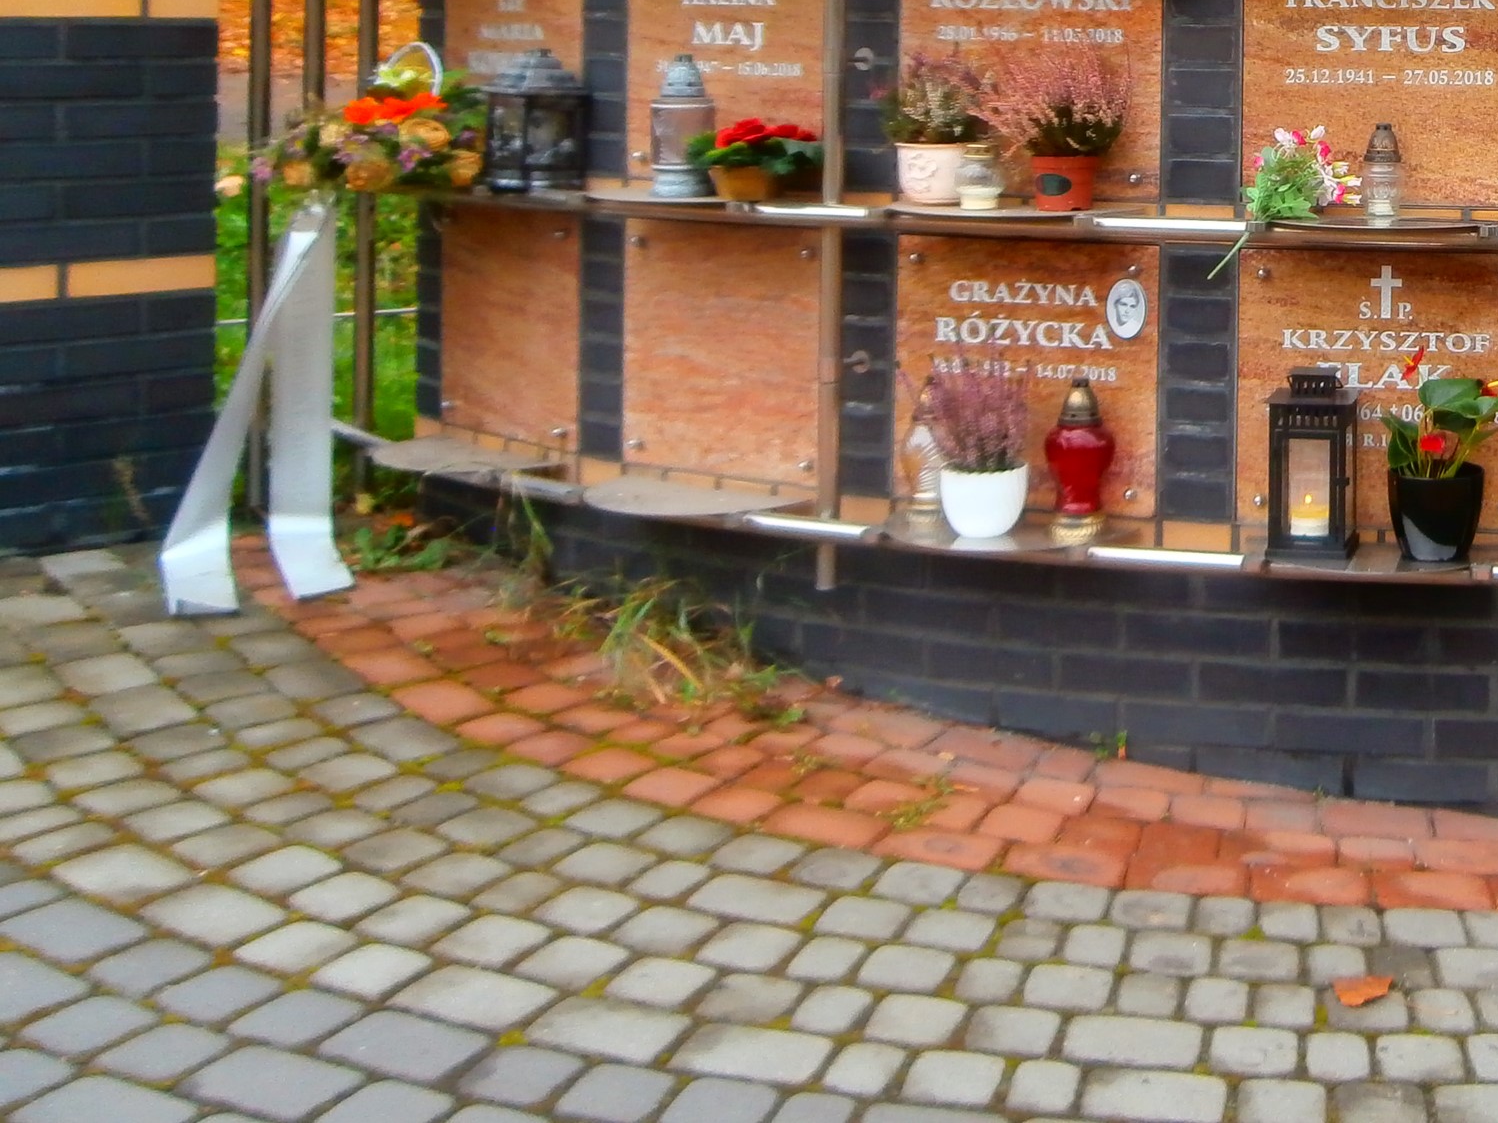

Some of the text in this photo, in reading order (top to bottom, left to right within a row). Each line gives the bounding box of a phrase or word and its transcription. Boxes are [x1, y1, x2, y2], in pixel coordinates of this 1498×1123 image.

[691, 20, 767, 51] MAJ
[1316, 26, 1466, 53] SYFUS
[1285, 68, 1374, 84] 25.12.1941
[1403, 69, 1494, 85] 27.05.2018
[950, 279, 1097, 306] GRAŻYNA
[935, 310, 1112, 349] RÓŻYCKA
[1282, 329, 1491, 352] KRZYSZTOF
[1036, 363, 1117, 381] 14.072018
